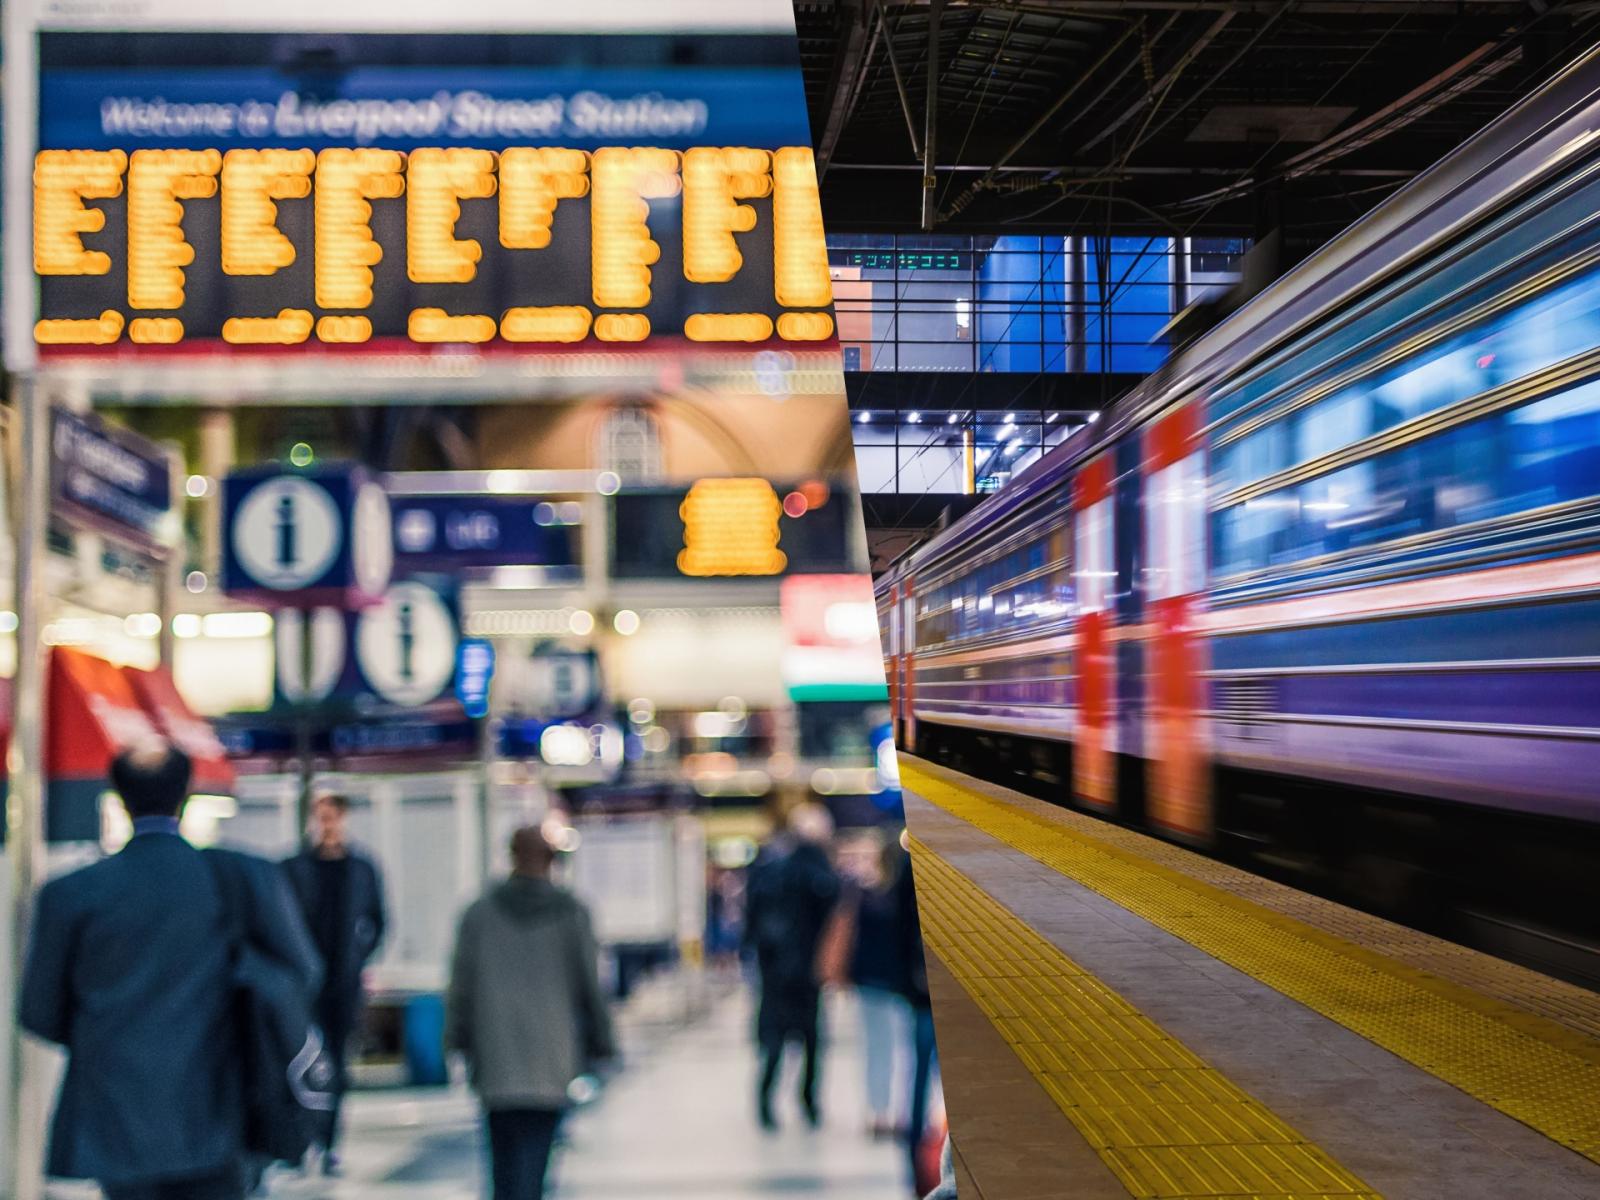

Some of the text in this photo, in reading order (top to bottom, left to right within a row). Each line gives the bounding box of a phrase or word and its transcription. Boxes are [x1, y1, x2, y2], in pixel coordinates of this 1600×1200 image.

[101, 91, 708, 145] Welcome to Liverpool Street Station
